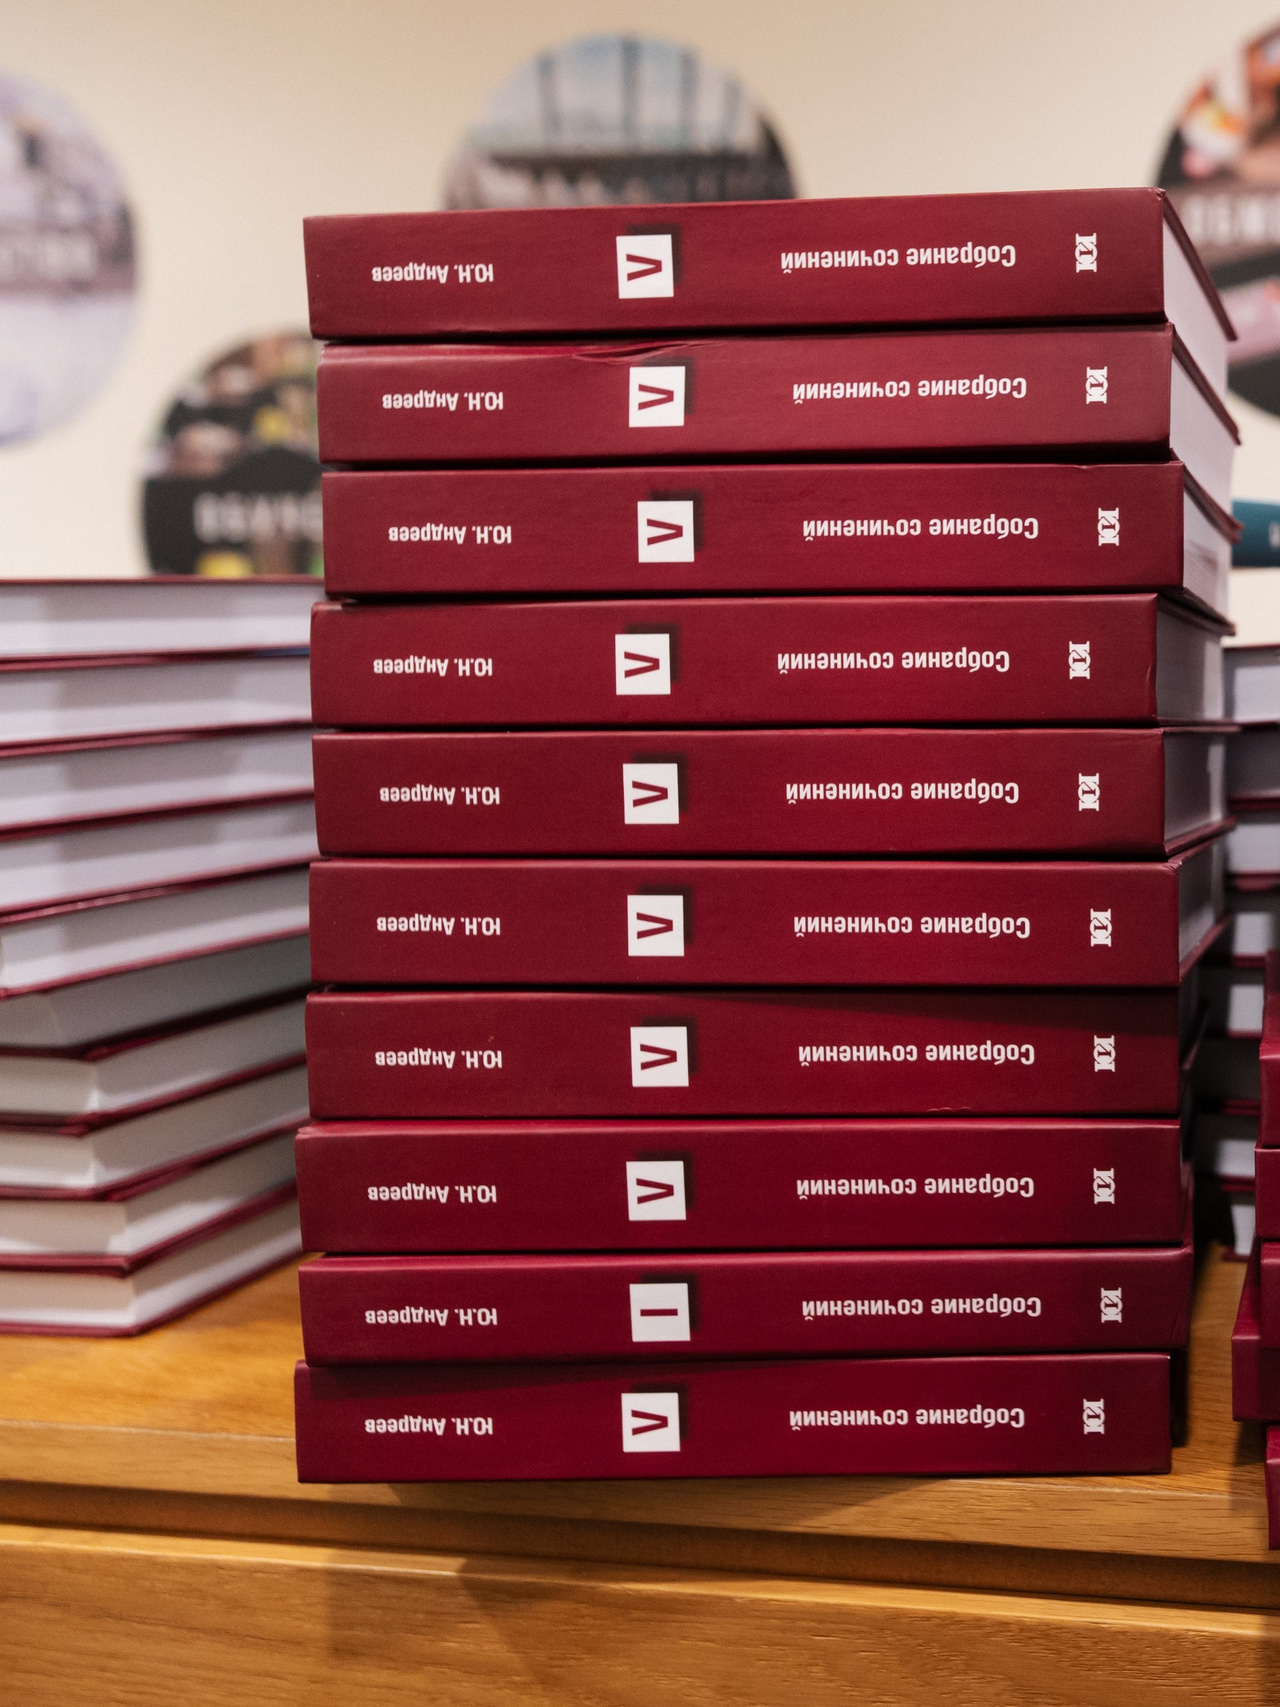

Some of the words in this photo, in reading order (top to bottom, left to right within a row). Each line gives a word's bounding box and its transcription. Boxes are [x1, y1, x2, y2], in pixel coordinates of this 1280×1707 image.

[781, 249, 898, 273] сочинений
[907, 242, 1015, 268] Собрание
[372, 262, 449, 284] Андреев
[453, 263, 494, 284] Ю.Н.
[793, 381, 910, 404] сочинений
[918, 374, 1027, 399] Собрание
[382, 390, 459, 411] Андреев
[464, 392, 503, 410] Ю.Н.
[389, 523, 466, 544] Андреев
[472, 526, 511, 544] Ю.Н.
[803, 519, 921, 541] сочинений
[929, 514, 1038, 539] Собрание
[373, 655, 448, 676] Андреев
[454, 658, 492, 676] Ю.Н.
[778, 652, 893, 674] сочинений
[902, 647, 1009, 672] Собрание
[380, 784, 455, 805] Андреев
[461, 787, 499, 805] Ю.Н.
[787, 783, 902, 804] сочинений
[911, 778, 1018, 803] Собрание
[377, 914, 455, 935] Андреев
[461, 917, 500, 935] Ю.Н.
[794, 917, 912, 937] сочинений
[921, 913, 1030, 938] Собрание
[375, 1048, 455, 1068] Андреев
[462, 1050, 502, 1068] Ю.Н.
[799, 1045, 917, 1066] сочинений
[926, 1040, 1034, 1065] Собрание
[368, 1183, 449, 1203] Андреев
[455, 1186, 496, 1202] Ю.Н.
[797, 1179, 916, 1199] сочинений
[925, 1174, 1034, 1197] Собрание
[365, 1306, 448, 1325] Андреев
[803, 1299, 922, 1320] сочинений
[932, 1294, 1041, 1317] Собрание
[455, 1308, 497, 1325] Ю.Н.
[365, 1415, 446, 1435] Андреев
[452, 1417, 492, 1435] Ю.Н.
[790, 1410, 908, 1430] сочинений
[916, 1405, 1024, 1428] Собрание
